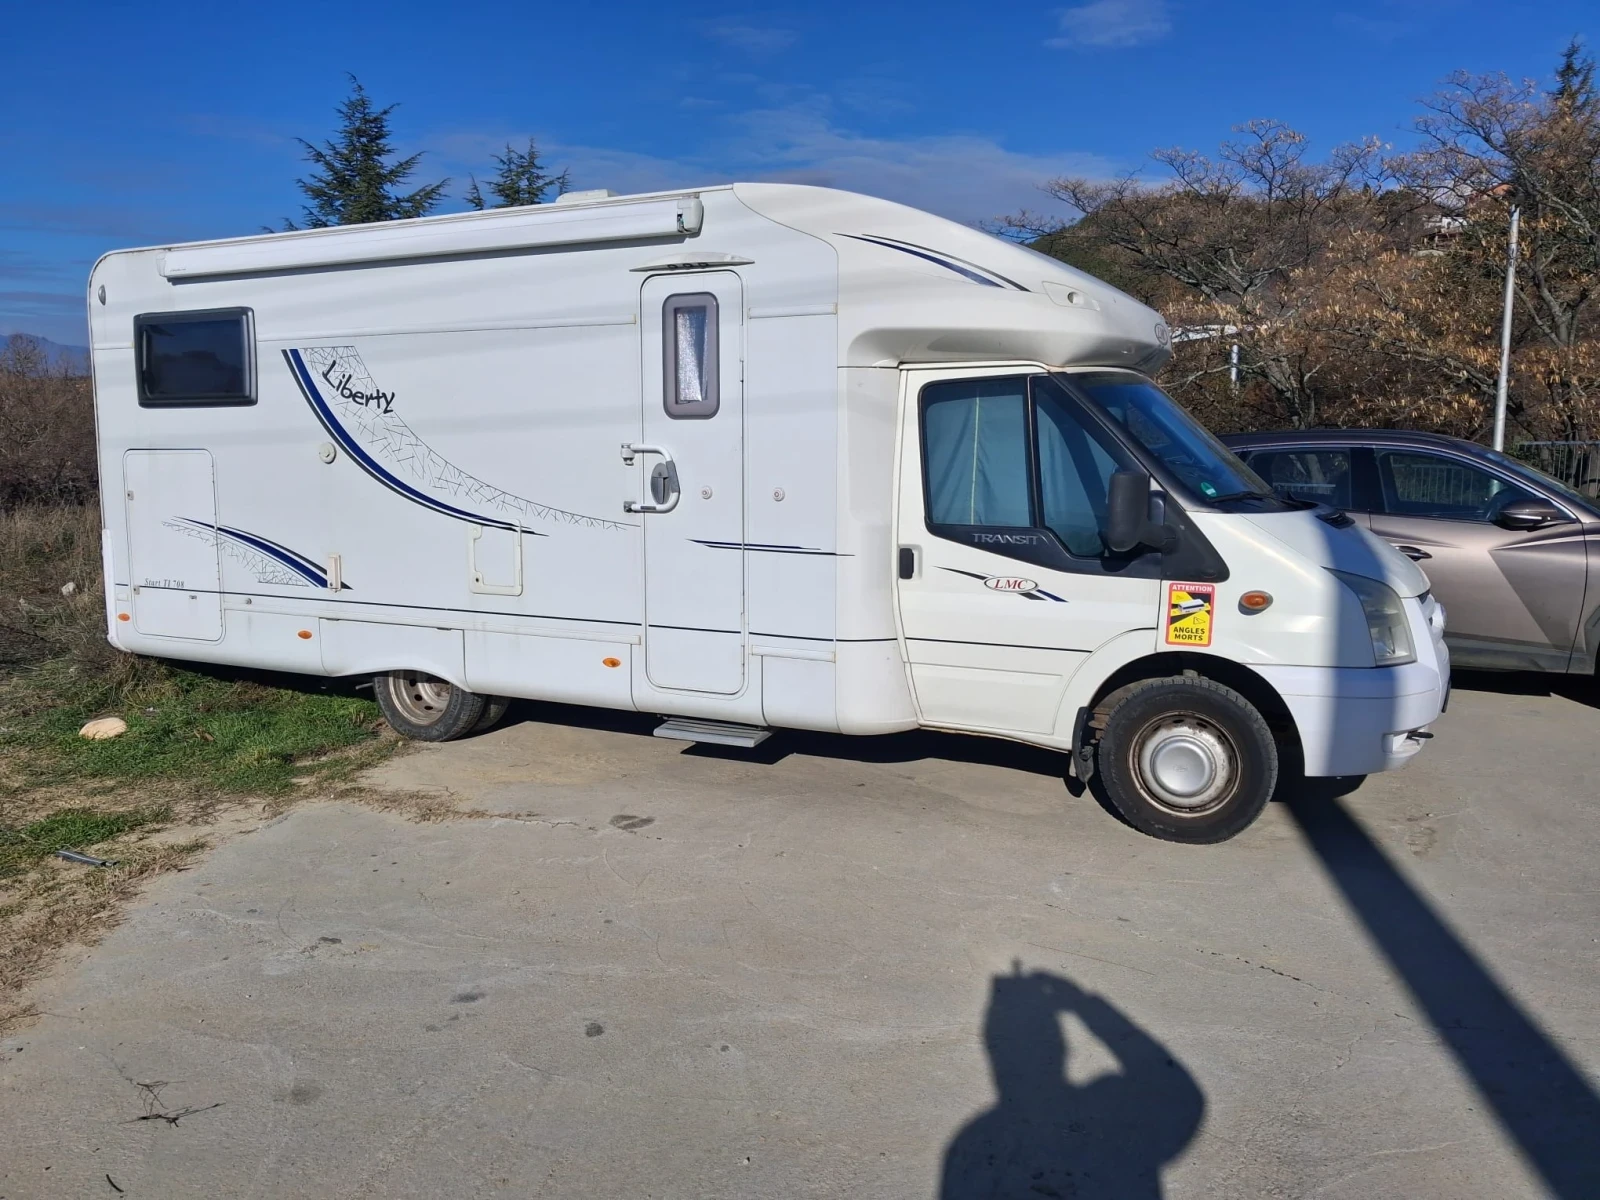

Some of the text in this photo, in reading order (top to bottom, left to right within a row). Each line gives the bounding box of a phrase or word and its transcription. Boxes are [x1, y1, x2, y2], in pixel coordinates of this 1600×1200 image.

[322, 360, 395, 414] Liberty
[972, 533, 1038, 545] TRANSIT
[144, 577, 161, 587] Start
[172, 580, 185, 589] 708
[994, 579, 1028, 590] LMC
[1172, 584, 1213, 592] ATTENTION
[1173, 626, 1206, 635] ANGLES
[1174, 633, 1204, 642] MORTS
